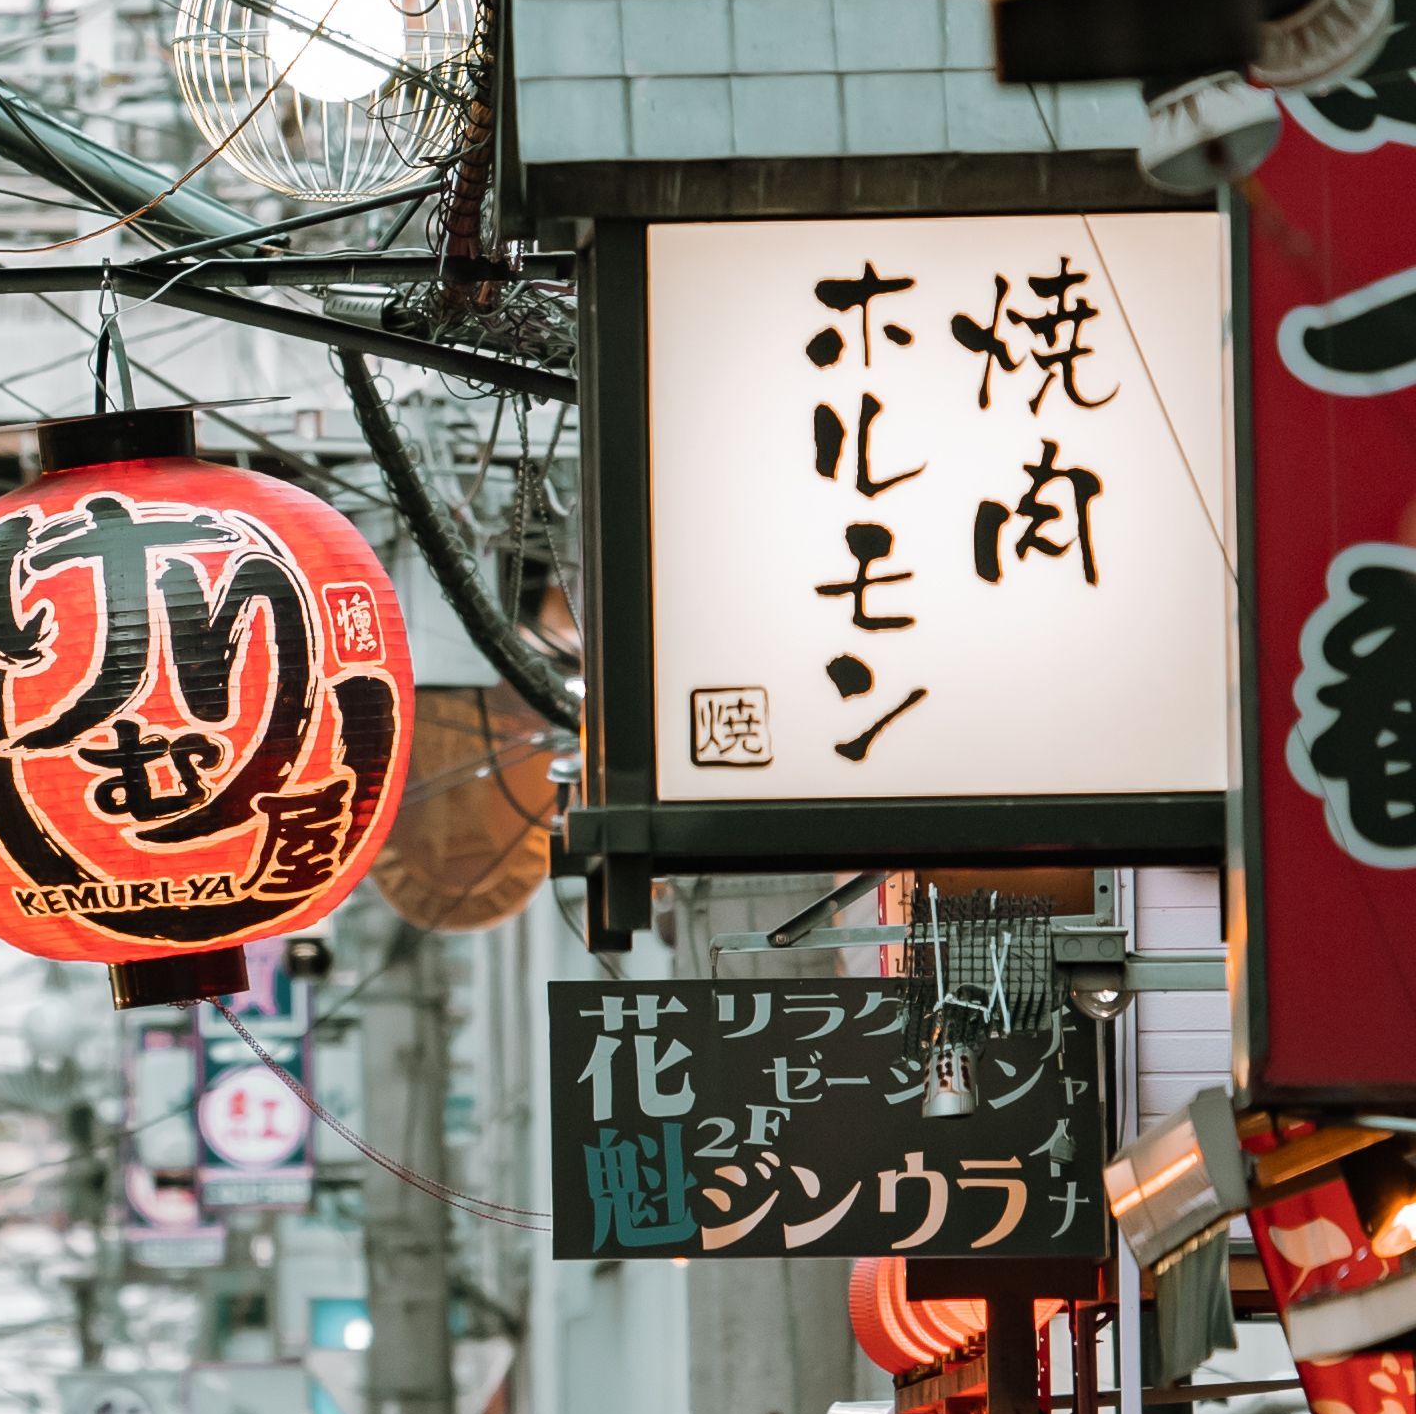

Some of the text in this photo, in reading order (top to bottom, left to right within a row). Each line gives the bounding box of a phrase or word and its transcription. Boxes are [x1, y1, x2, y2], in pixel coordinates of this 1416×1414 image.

[951, 256, 1122, 587] 焼肉
[805, 259, 927, 763] ホルモン
[697, 697, 764, 757] 焼
[14, 875, 237, 917] KEMURI-YA
[762, 1049, 1047, 1111] ゼーシン
[577, 994, 699, 1253] 花魁
[693, 1103, 791, 1159] 2F
[700, 1150, 1029, 1252] ジンウラ
